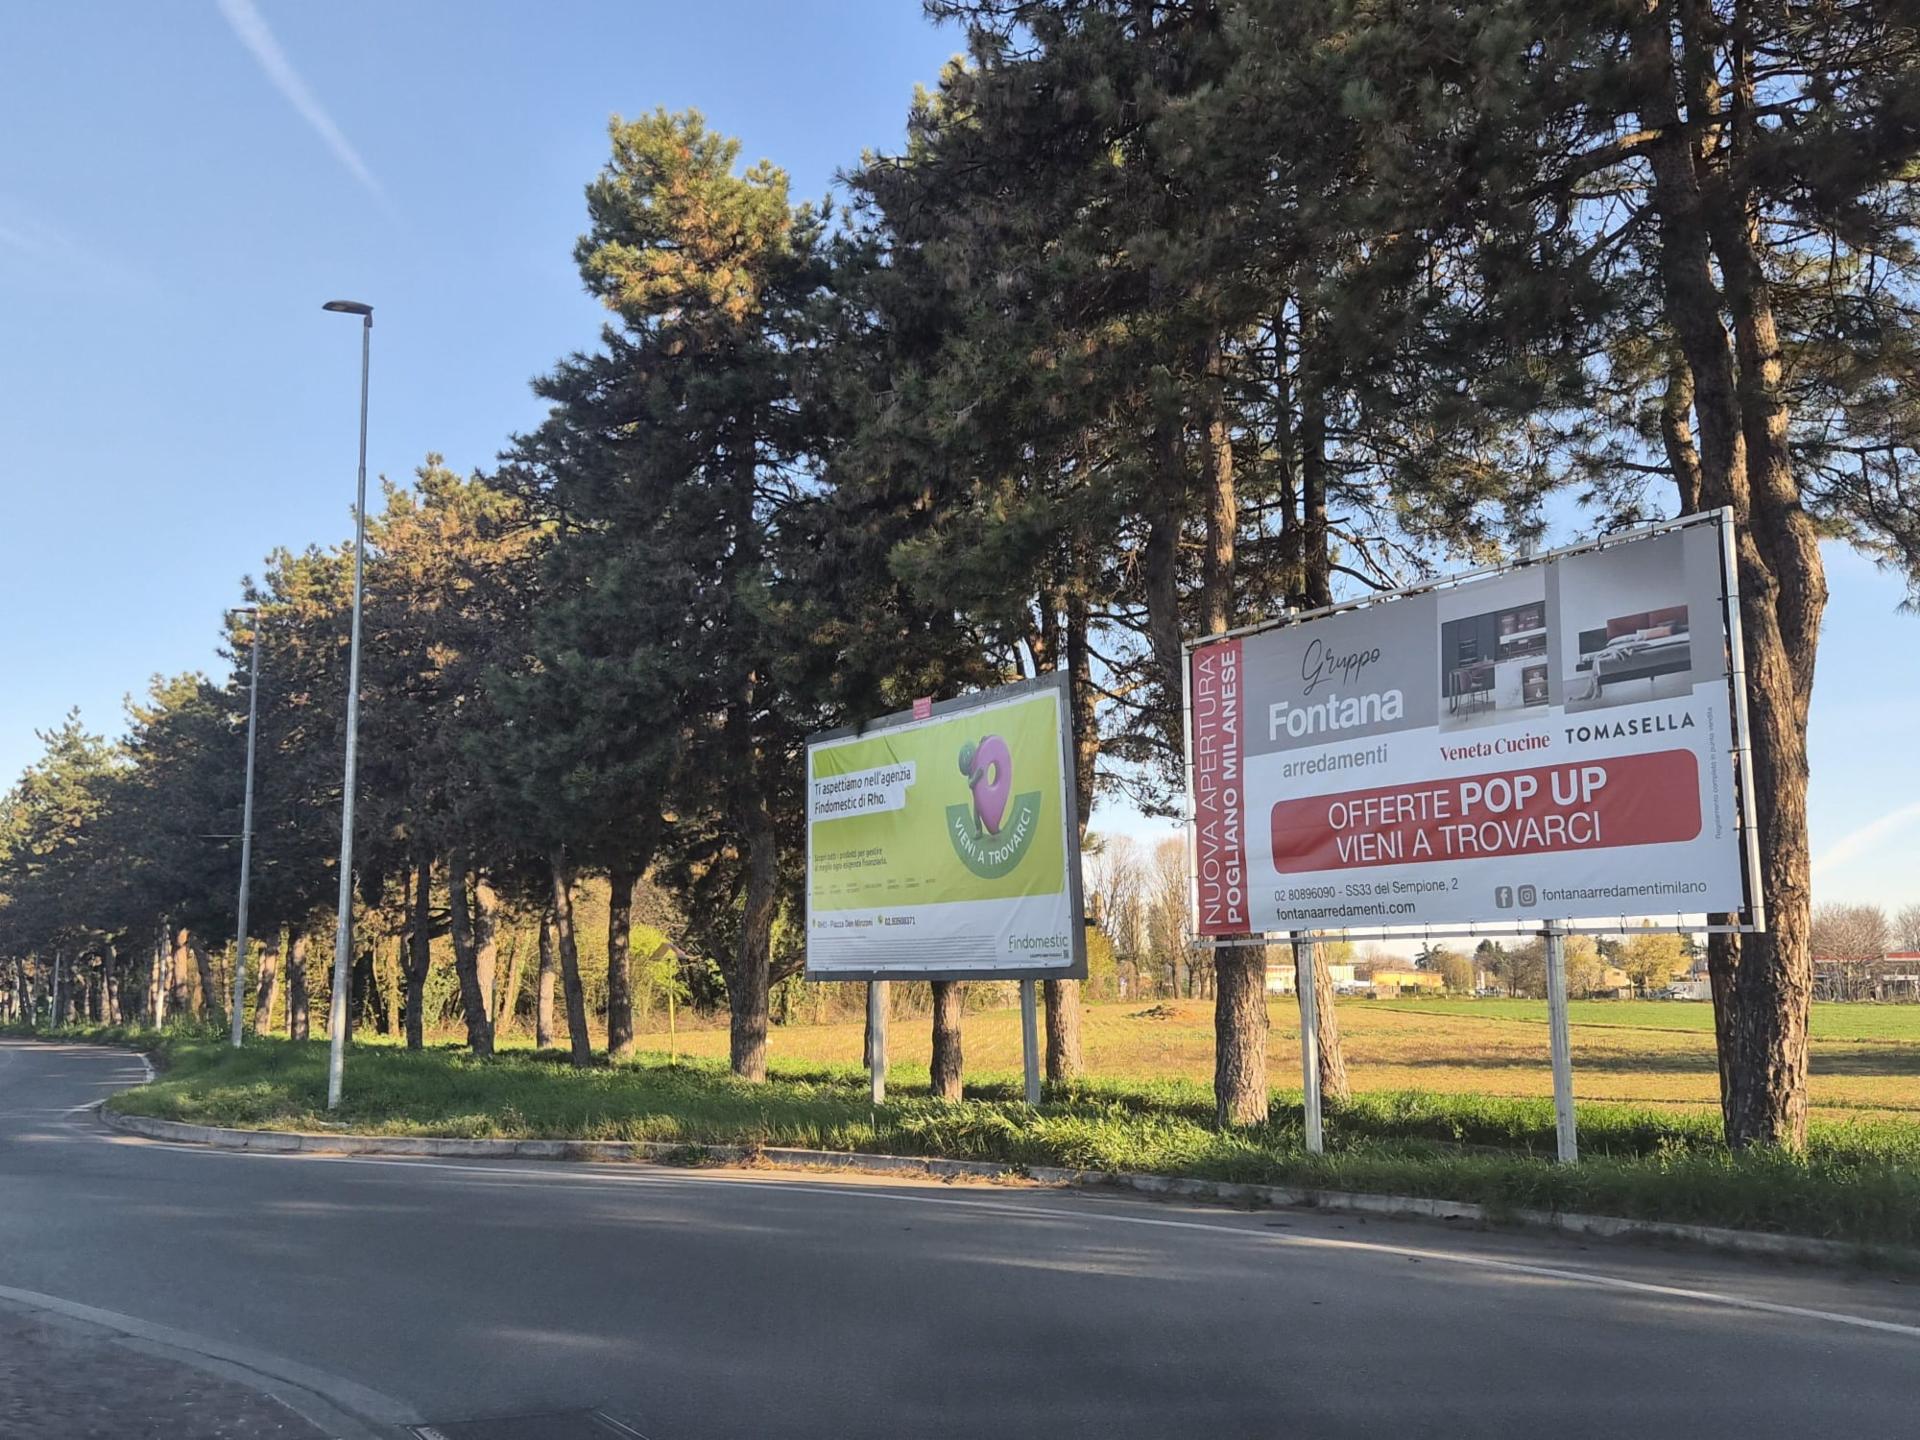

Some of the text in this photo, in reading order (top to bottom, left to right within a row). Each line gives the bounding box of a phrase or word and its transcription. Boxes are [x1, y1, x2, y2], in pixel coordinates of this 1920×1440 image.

[1301, 638, 1381, 696] Gruppo
[1268, 689, 1403, 741] Fontana
[1565, 711, 1696, 744] TOMASELLA
[1283, 744, 1388, 778] arredamenti
[1440, 732, 1550, 761] Veneta Cucine
[814, 768, 911, 797] Ti aspettiamo nell'agenzia
[1198, 655, 1222, 925] NUOVA APERTURA
[1220, 650, 1242, 923] POGLIANO MILANESE
[1328, 766, 1608, 830] OFFERTE POP UP
[814, 793, 886, 814] Findomestic di Rho.
[955, 807, 1031, 865] VIENI A TROVARCI
[1336, 811, 1601, 863] VIENI A TROVARCI
[1274, 890, 1286, 902] 02
[1288, 886, 1336, 901] 80896090
[1345, 883, 1371, 897] SS33
[1374, 881, 1390, 895] del
[1392, 880, 1449, 895] Sempione,
[1451, 877, 1459, 890] 2
[1542, 880, 1708, 902] fontanaarredamentimilano
[1276, 901, 1416, 920] fontanaarredamenti.com
